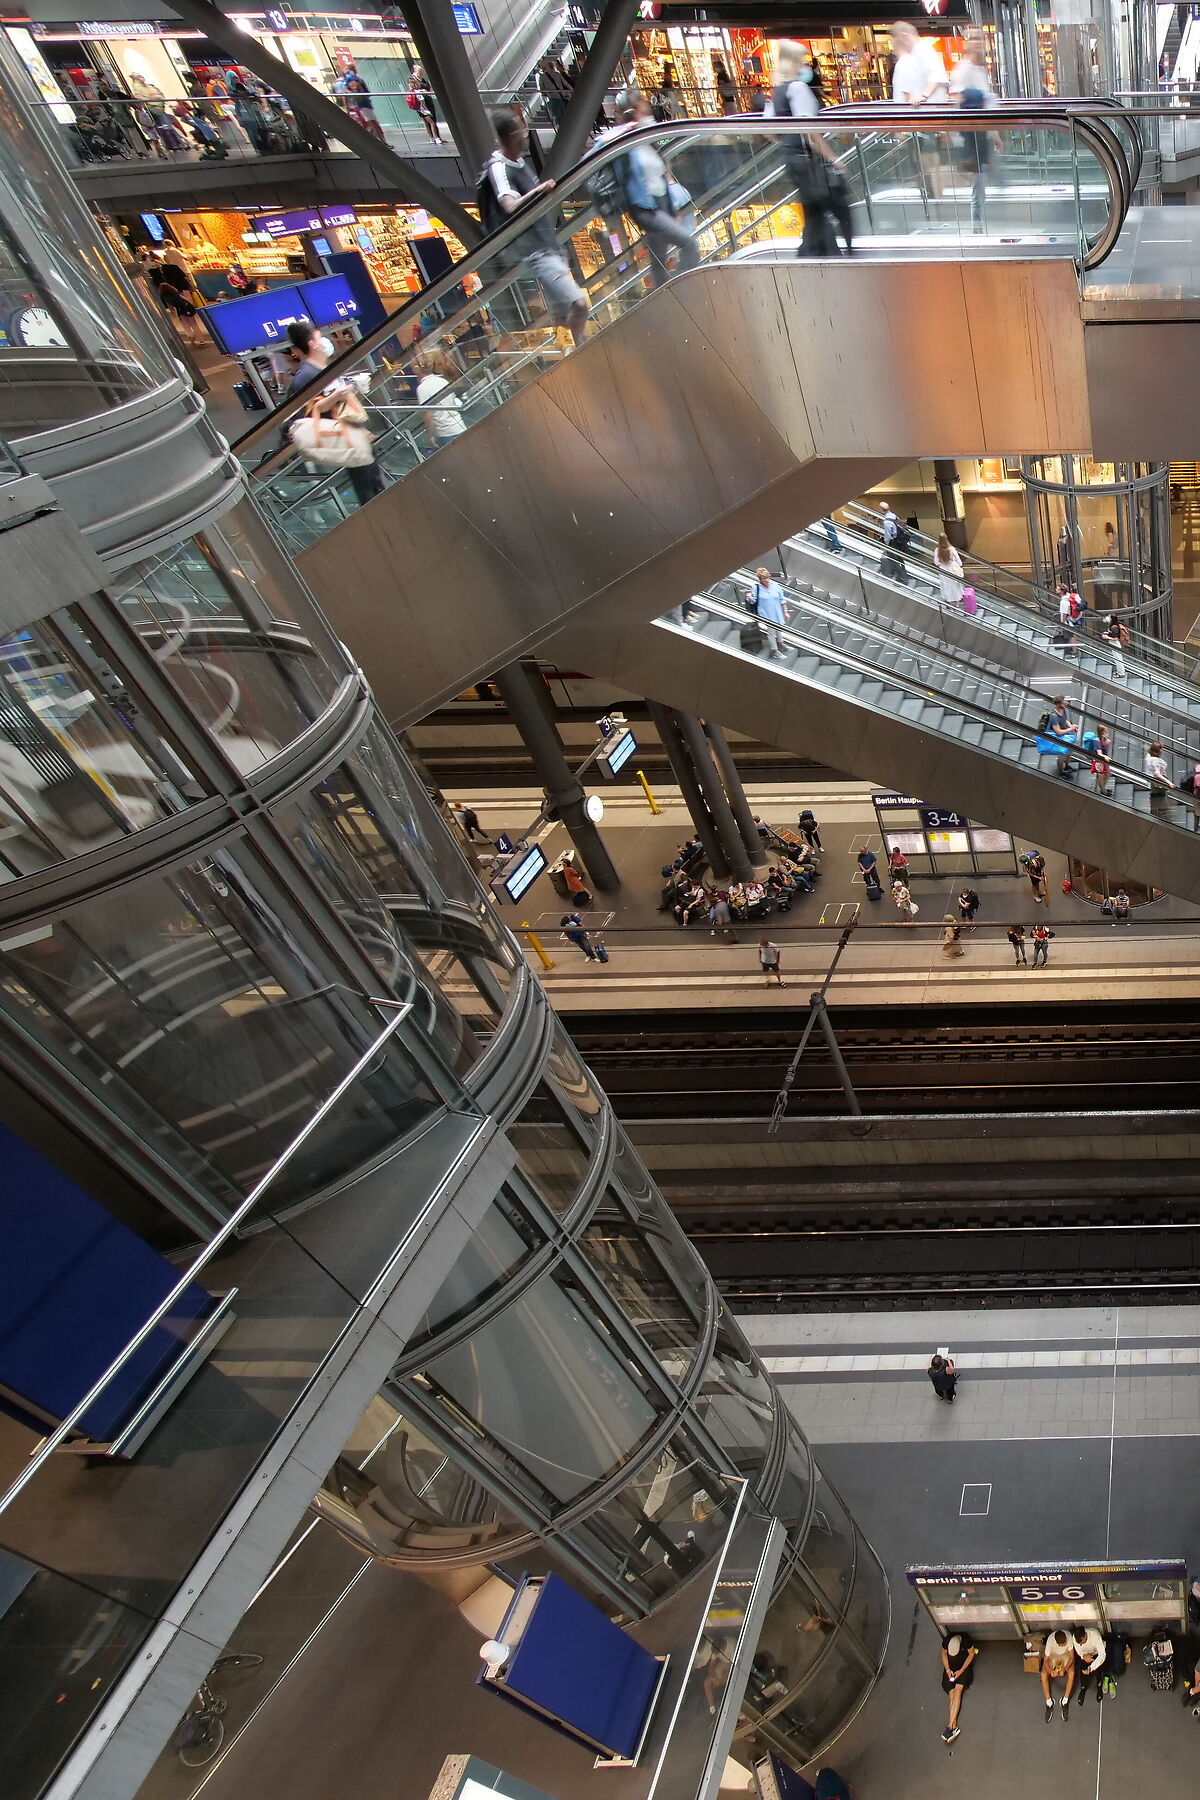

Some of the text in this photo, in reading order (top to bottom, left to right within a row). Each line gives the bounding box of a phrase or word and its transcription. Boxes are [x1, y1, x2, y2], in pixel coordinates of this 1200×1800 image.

[269, 11, 287, 29] 13
[602, 719, 610, 730] 3
[927, 811, 961, 827] 3-4
[499, 838, 508, 850] 4
[961, 1574, 1063, 1584] Hauptbahnhof
[1021, 1586, 1085, 1601] 5-6
